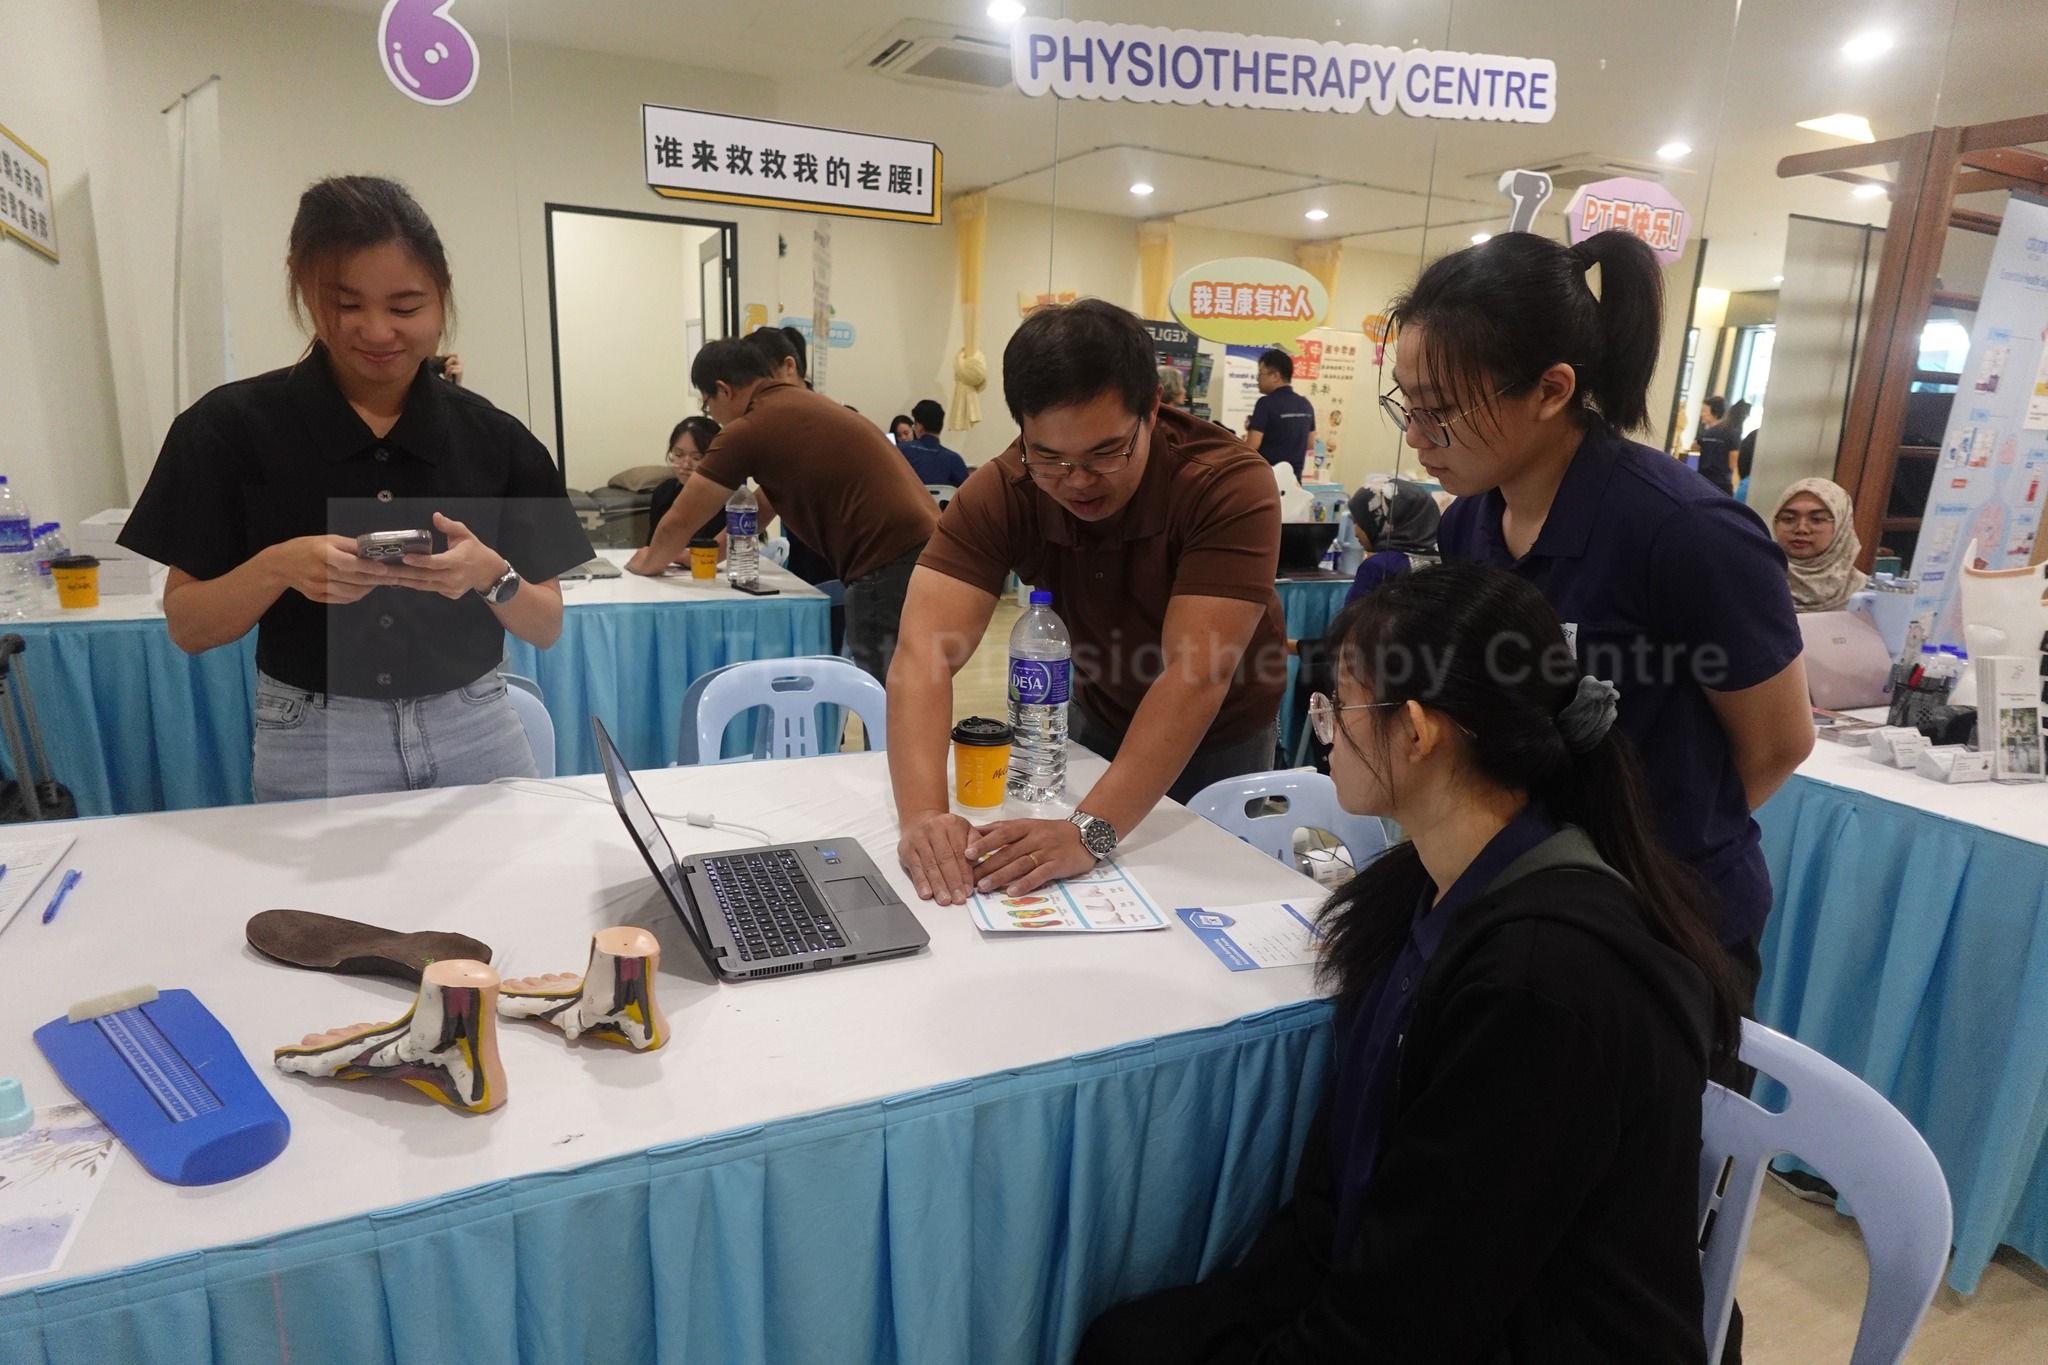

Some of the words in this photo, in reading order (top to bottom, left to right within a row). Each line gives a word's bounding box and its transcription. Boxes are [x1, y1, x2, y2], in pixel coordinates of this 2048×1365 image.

[1028, 33, 1396, 100] PHYSIOTHERAPY
[1406, 62, 1550, 110] CENTRE
[655, 135, 923, 195] 谁来救救我的老腰!
[1192, 283, 1315, 321] 我是康复达人
[1012, 674, 1043, 691] DESA
